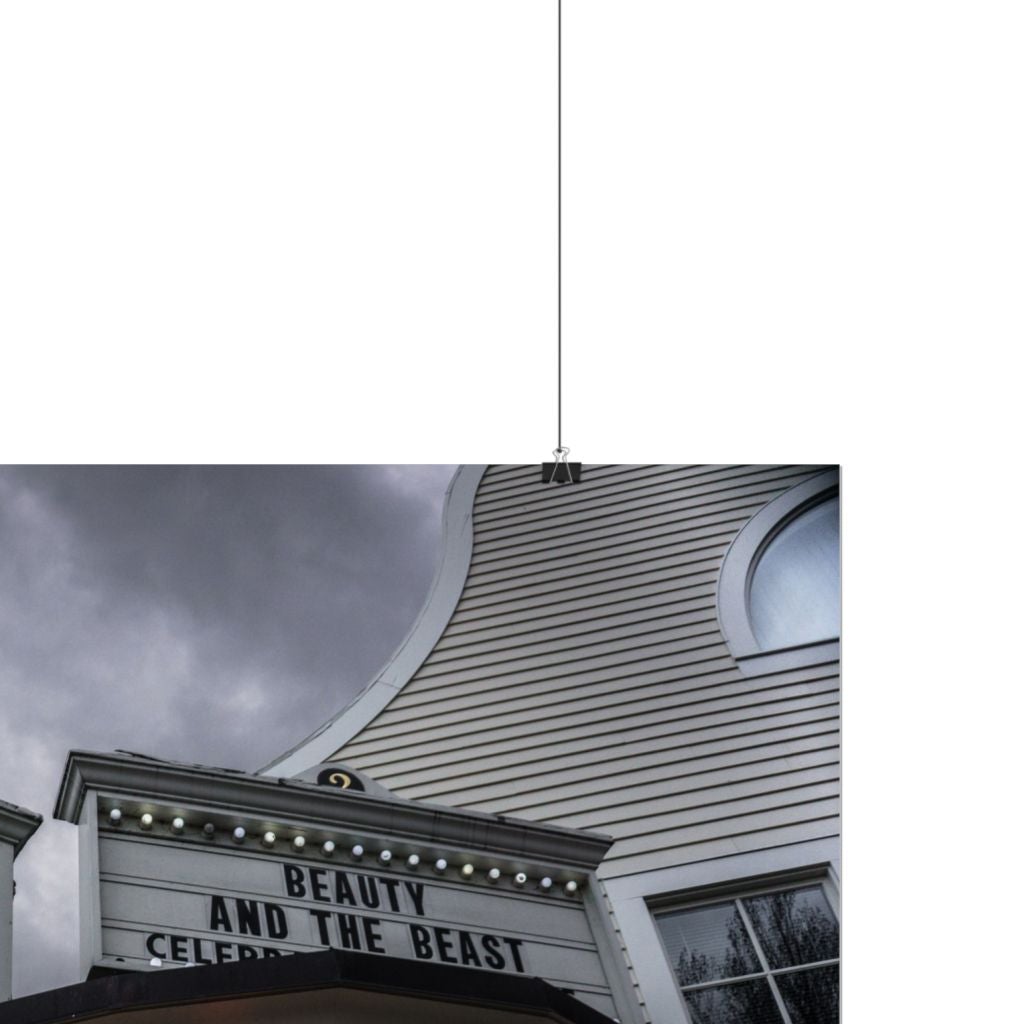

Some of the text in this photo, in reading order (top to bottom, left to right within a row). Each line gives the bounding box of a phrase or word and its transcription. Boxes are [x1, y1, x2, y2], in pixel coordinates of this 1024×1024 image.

[283, 864, 425, 916] BEAUTY
[210, 895, 525, 973] AND THE BEAST
